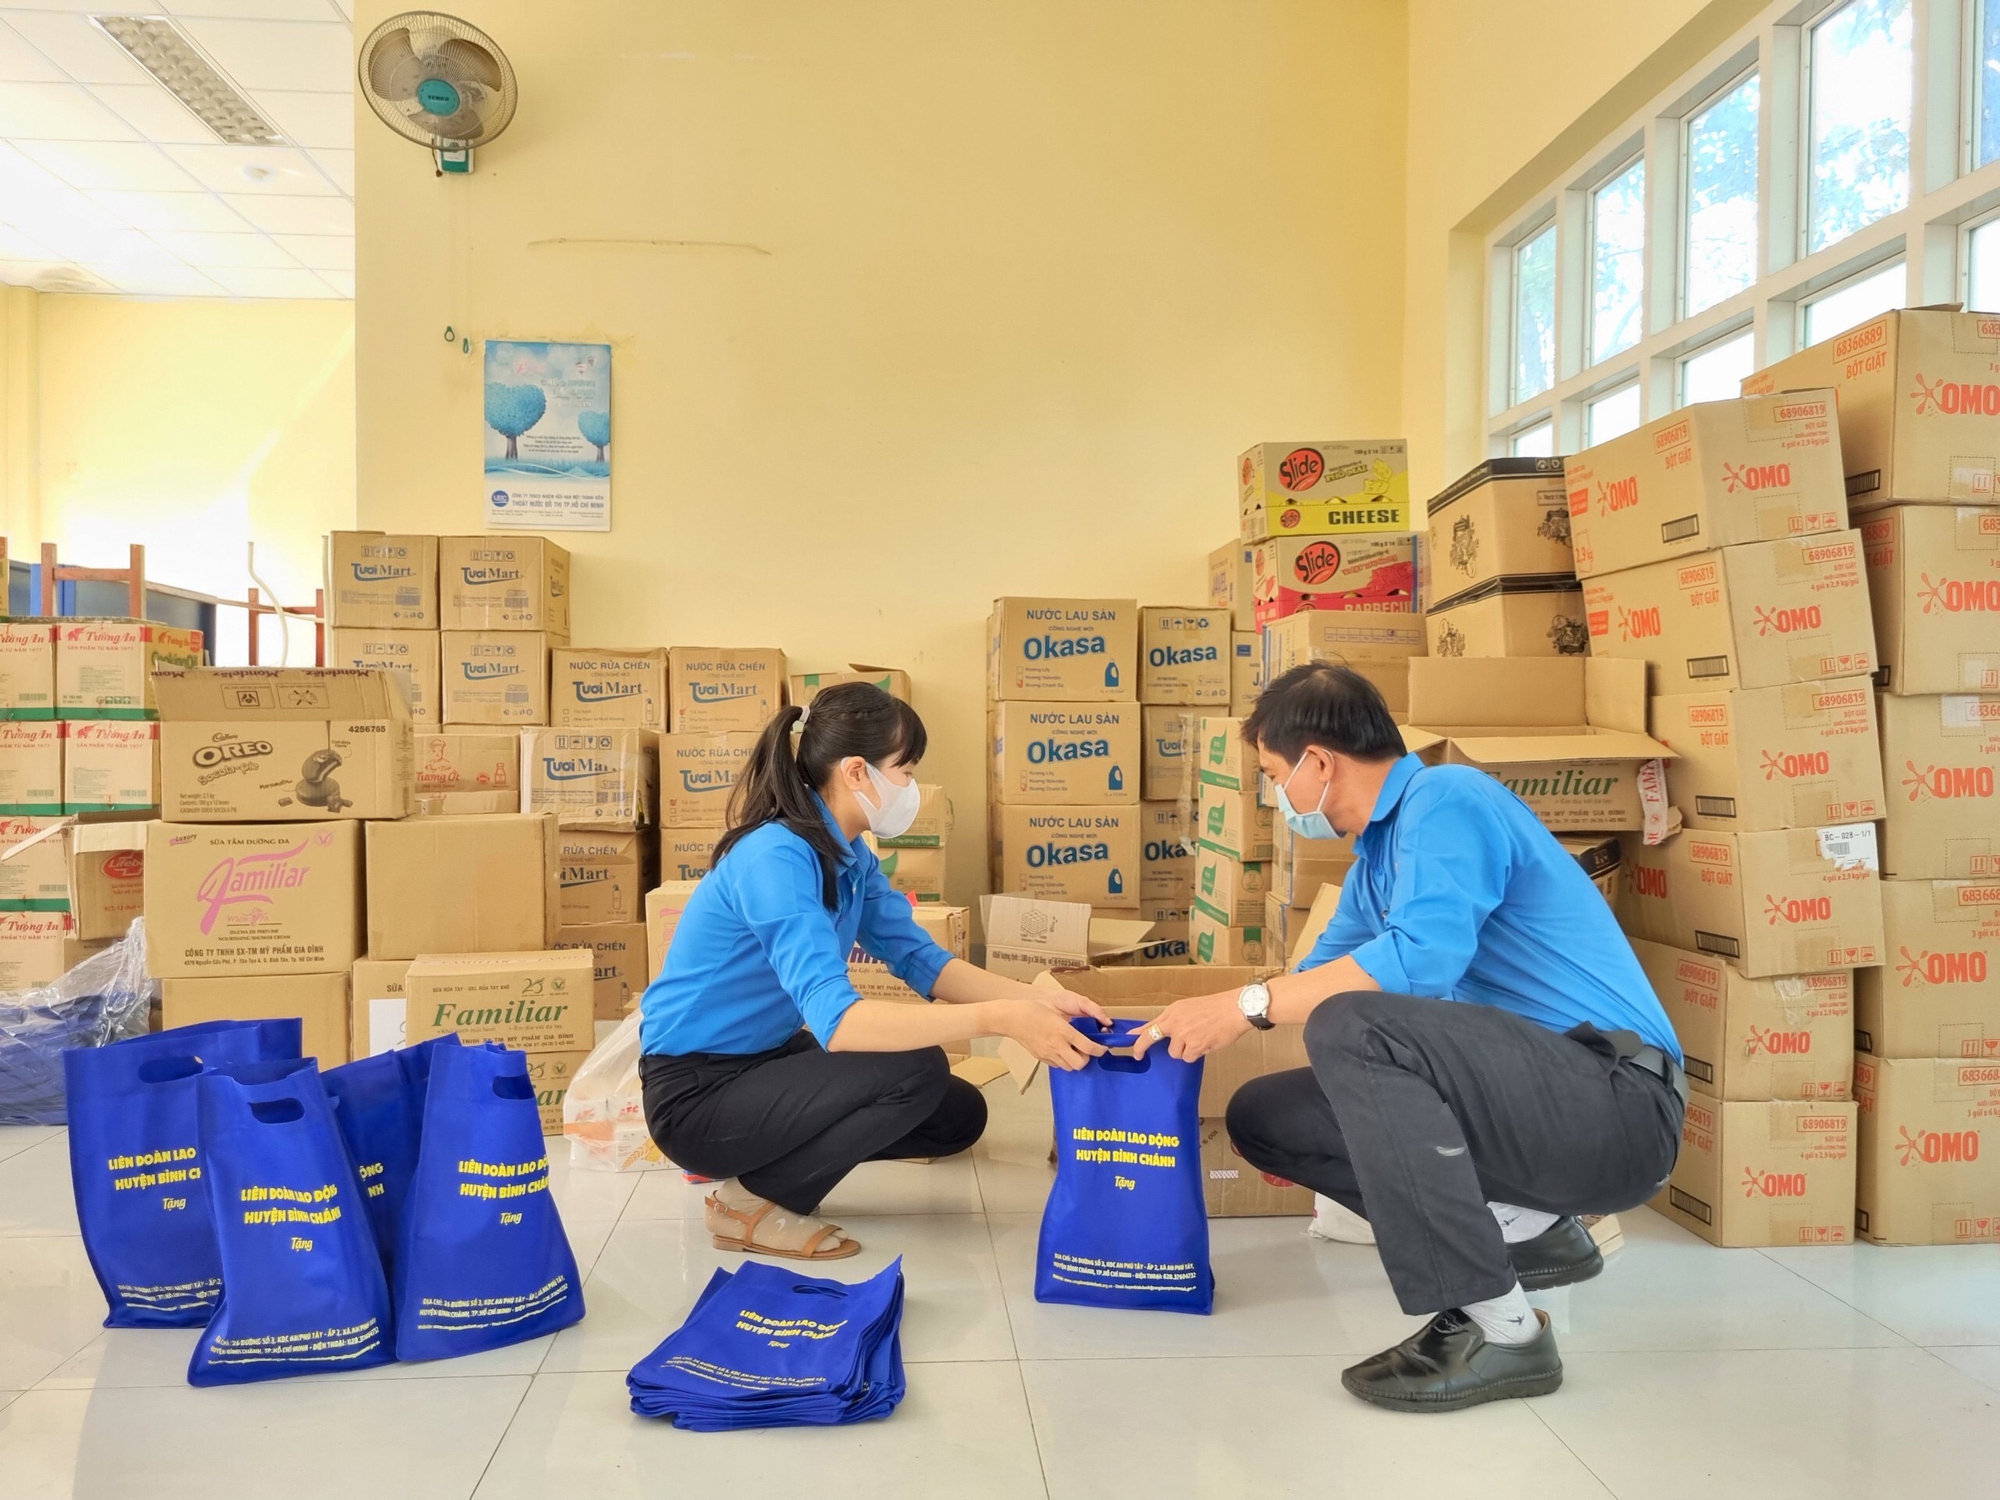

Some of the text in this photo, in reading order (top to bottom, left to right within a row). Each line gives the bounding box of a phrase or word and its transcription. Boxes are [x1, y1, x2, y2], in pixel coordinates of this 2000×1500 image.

[1836, 326, 1882, 357] 68366889
[1846, 351, 1887, 380] BỘT GIẶT
[1942, 383, 2000, 415] OMO
[1780, 405, 1826, 419] 68906819
[1656, 424, 1687, 447] 68906819
[1280, 459, 1319, 488] Slide
[1745, 463, 1791, 491] OMO
[1610, 477, 1638, 512] OMO
[1328, 509, 1399, 525] CHEESE
[1809, 546, 1853, 561] 68906819
[351, 563, 412, 578] Tươi Mart
[461, 567, 520, 582] Tươi Mart
[1295, 552, 1336, 582] Slide
[1680, 566, 1715, 585] 68906819
[1946, 580, 2000, 612] OMO
[1026, 608, 1116, 620] NƯỚC LAU SÀN
[1631, 607, 1661, 639] OMO
[1777, 605, 1821, 633] OMO
[86, 631, 120, 644] Tường
[1024, 635, 1106, 661] Okasa
[1149, 646, 1217, 667] Okasa
[461, 662, 520, 678] Tươi Mart
[569, 659, 651, 670] NƯỚC RỬA CHÉN
[686, 660, 766, 671] NƯỚC RỬA CHÉN
[572, 681, 643, 700] Tươi Mart
[689, 682, 758, 701] Tươi Mart
[1818, 693, 1865, 707] 68906819
[1030, 711, 1120, 724] NƯỚC LAU SÀN
[1691, 708, 1725, 722] 68906819
[3, 729, 36, 741] Tường
[348, 725, 386, 733] 4256785
[1700, 731, 1729, 748] BỘT GIẶT
[194, 740, 273, 768] OREO
[676, 747, 730, 758] NƯỚC RỬA
[1027, 739, 1109, 764] Okasa
[543, 757, 576, 776] Tươi
[1784, 751, 1829, 778] OMO
[680, 770, 712, 790] Tươi
[1933, 766, 1994, 799] OMO
[1029, 814, 1119, 828] NƯỚC LAU SÀN
[563, 843, 618, 855] RỬA CHÉN
[675, 843, 703, 852] NƯỚC
[1027, 841, 1109, 868] Okasa
[1692, 845, 1729, 862] 68906819
[569, 867, 609, 880] Mart
[1638, 866, 1667, 899] OMO
[1701, 869, 1733, 888] BỘT GIẶT
[1787, 897, 1831, 923] OMO
[185, 943, 324, 957] CÔNG TY TNHH SX-TM MỸ PHẨM GIA ĐÌNH
[597, 941, 626, 950] CHÉN
[1679, 963, 1717, 985] 68906819
[1927, 951, 1987, 984] OMO
[387, 984, 403, 993] SỮA
[1684, 989, 1718, 1012] BỘT GIẶT
[432, 1000, 568, 1027] Familiar
[1769, 1031, 1811, 1054] OMO
[1803, 1119, 1847, 1130] 68906819
[1073, 1126, 1094, 1141] LIÊN
[1127, 1131, 1147, 1145] LAO
[1924, 1131, 1979, 1163] OMO
[108, 1155, 134, 1170] LIÊN
[174, 1147, 196, 1161] LAO
[1076, 1148, 1176, 1167] HUYỆN BÌNH CHÁNH
[458, 1159, 482, 1176] LIÊN
[517, 1160, 536, 1175] LAO
[115, 1173, 156, 1190] HUYỆN
[158, 1168, 186, 1184] BÌNH
[1114, 1175, 1136, 1190] Tặng
[1764, 1174, 1806, 1197] OMO
[241, 1186, 267, 1201] LIÊN
[295, 1191, 312, 1203] LAO
[459, 1182, 525, 1200] HUYỆN BÌNH
[163, 1197, 186, 1211] Tặng
[244, 1207, 310, 1226] HUYỆN BÌNH
[500, 1211, 523, 1226] Tặng
[291, 1237, 313, 1252] Tặng
[739, 1309, 763, 1322] LIÊN
[795, 1319, 818, 1328] LAO
[736, 1320, 801, 1337] HUYỆN BÌNH
